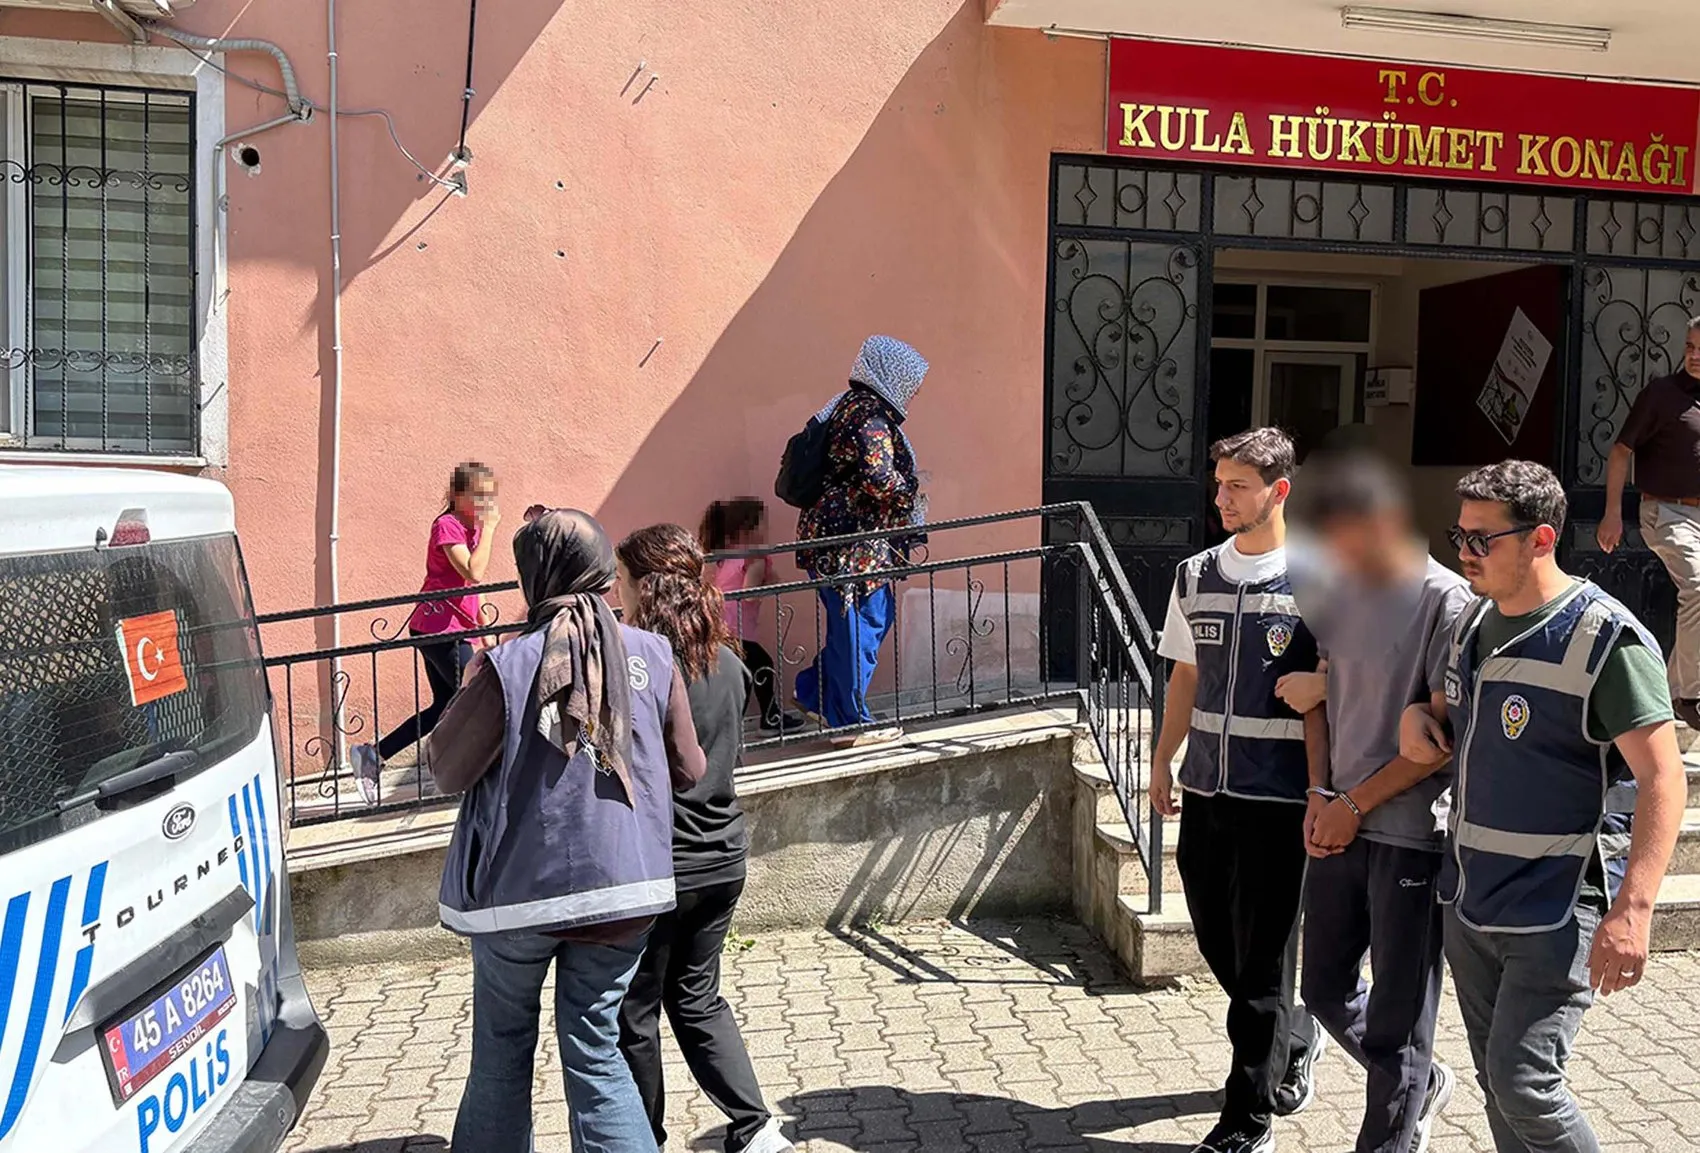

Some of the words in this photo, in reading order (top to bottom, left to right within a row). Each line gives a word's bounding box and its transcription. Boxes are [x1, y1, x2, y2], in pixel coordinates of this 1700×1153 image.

[1379, 69, 1458, 108] T.C.
[1119, 102, 1254, 156] KULA
[1267, 106, 1503, 173] HÜKÜMET
[1516, 132, 1689, 187] KONAĞI
[82, 835, 245, 944] TOURNEO
[133, 1009, 162, 1054] 45
[164, 997, 182, 1035] A
[180, 961, 224, 1018] 8264
